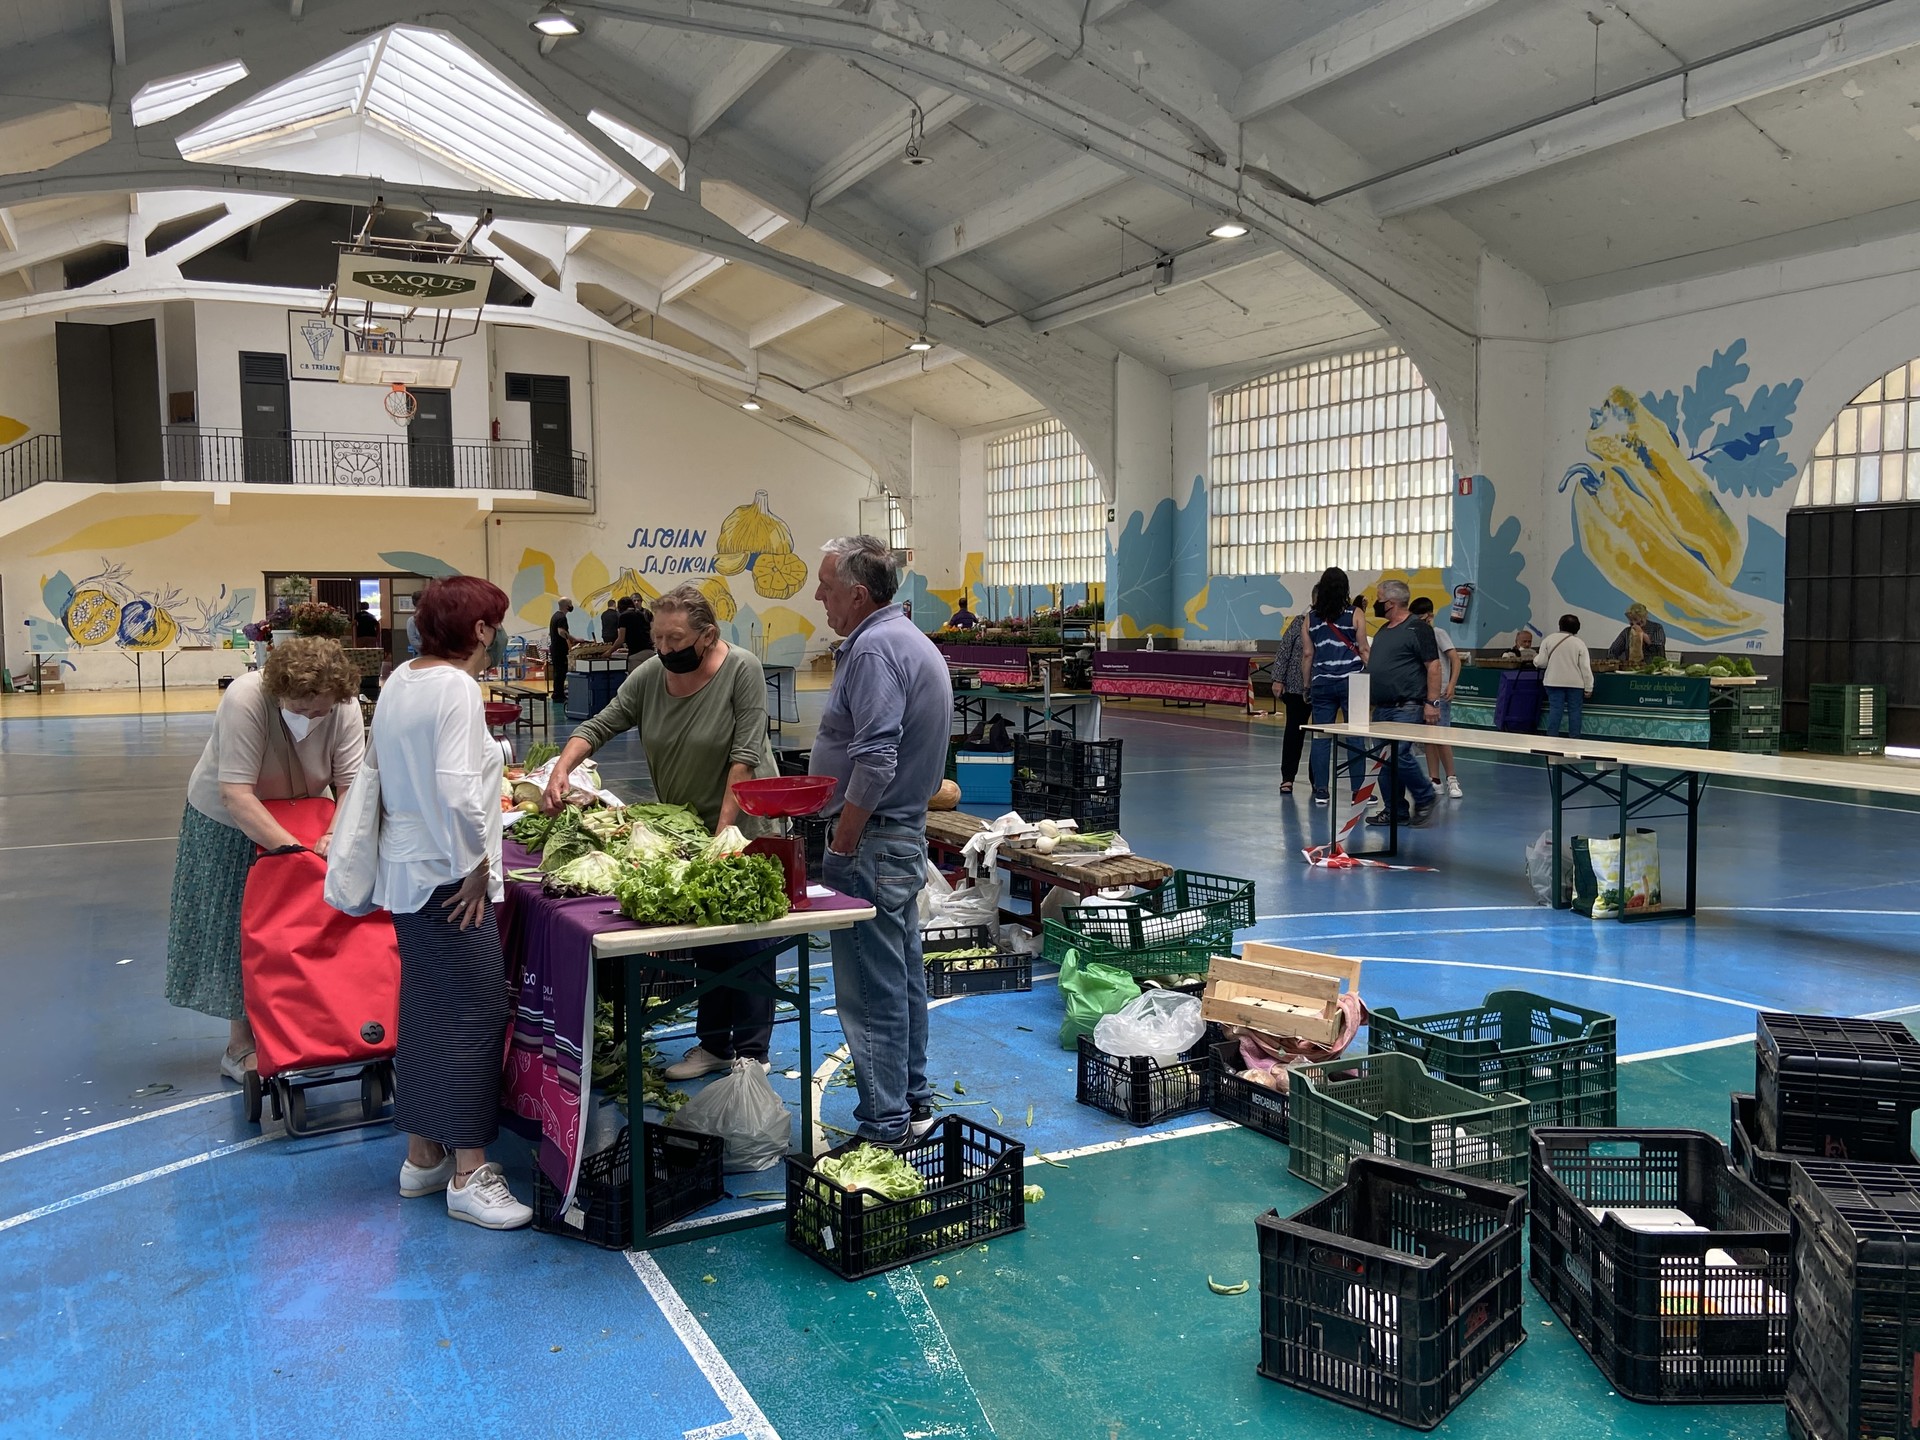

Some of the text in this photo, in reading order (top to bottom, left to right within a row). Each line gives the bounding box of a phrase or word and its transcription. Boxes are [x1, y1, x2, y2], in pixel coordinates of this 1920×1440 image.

[366, 273, 466, 291] BAQUÉ
[627, 528, 707, 549] SASOIAN
[1252, 1092, 1281, 1113] MERCABILBAO
